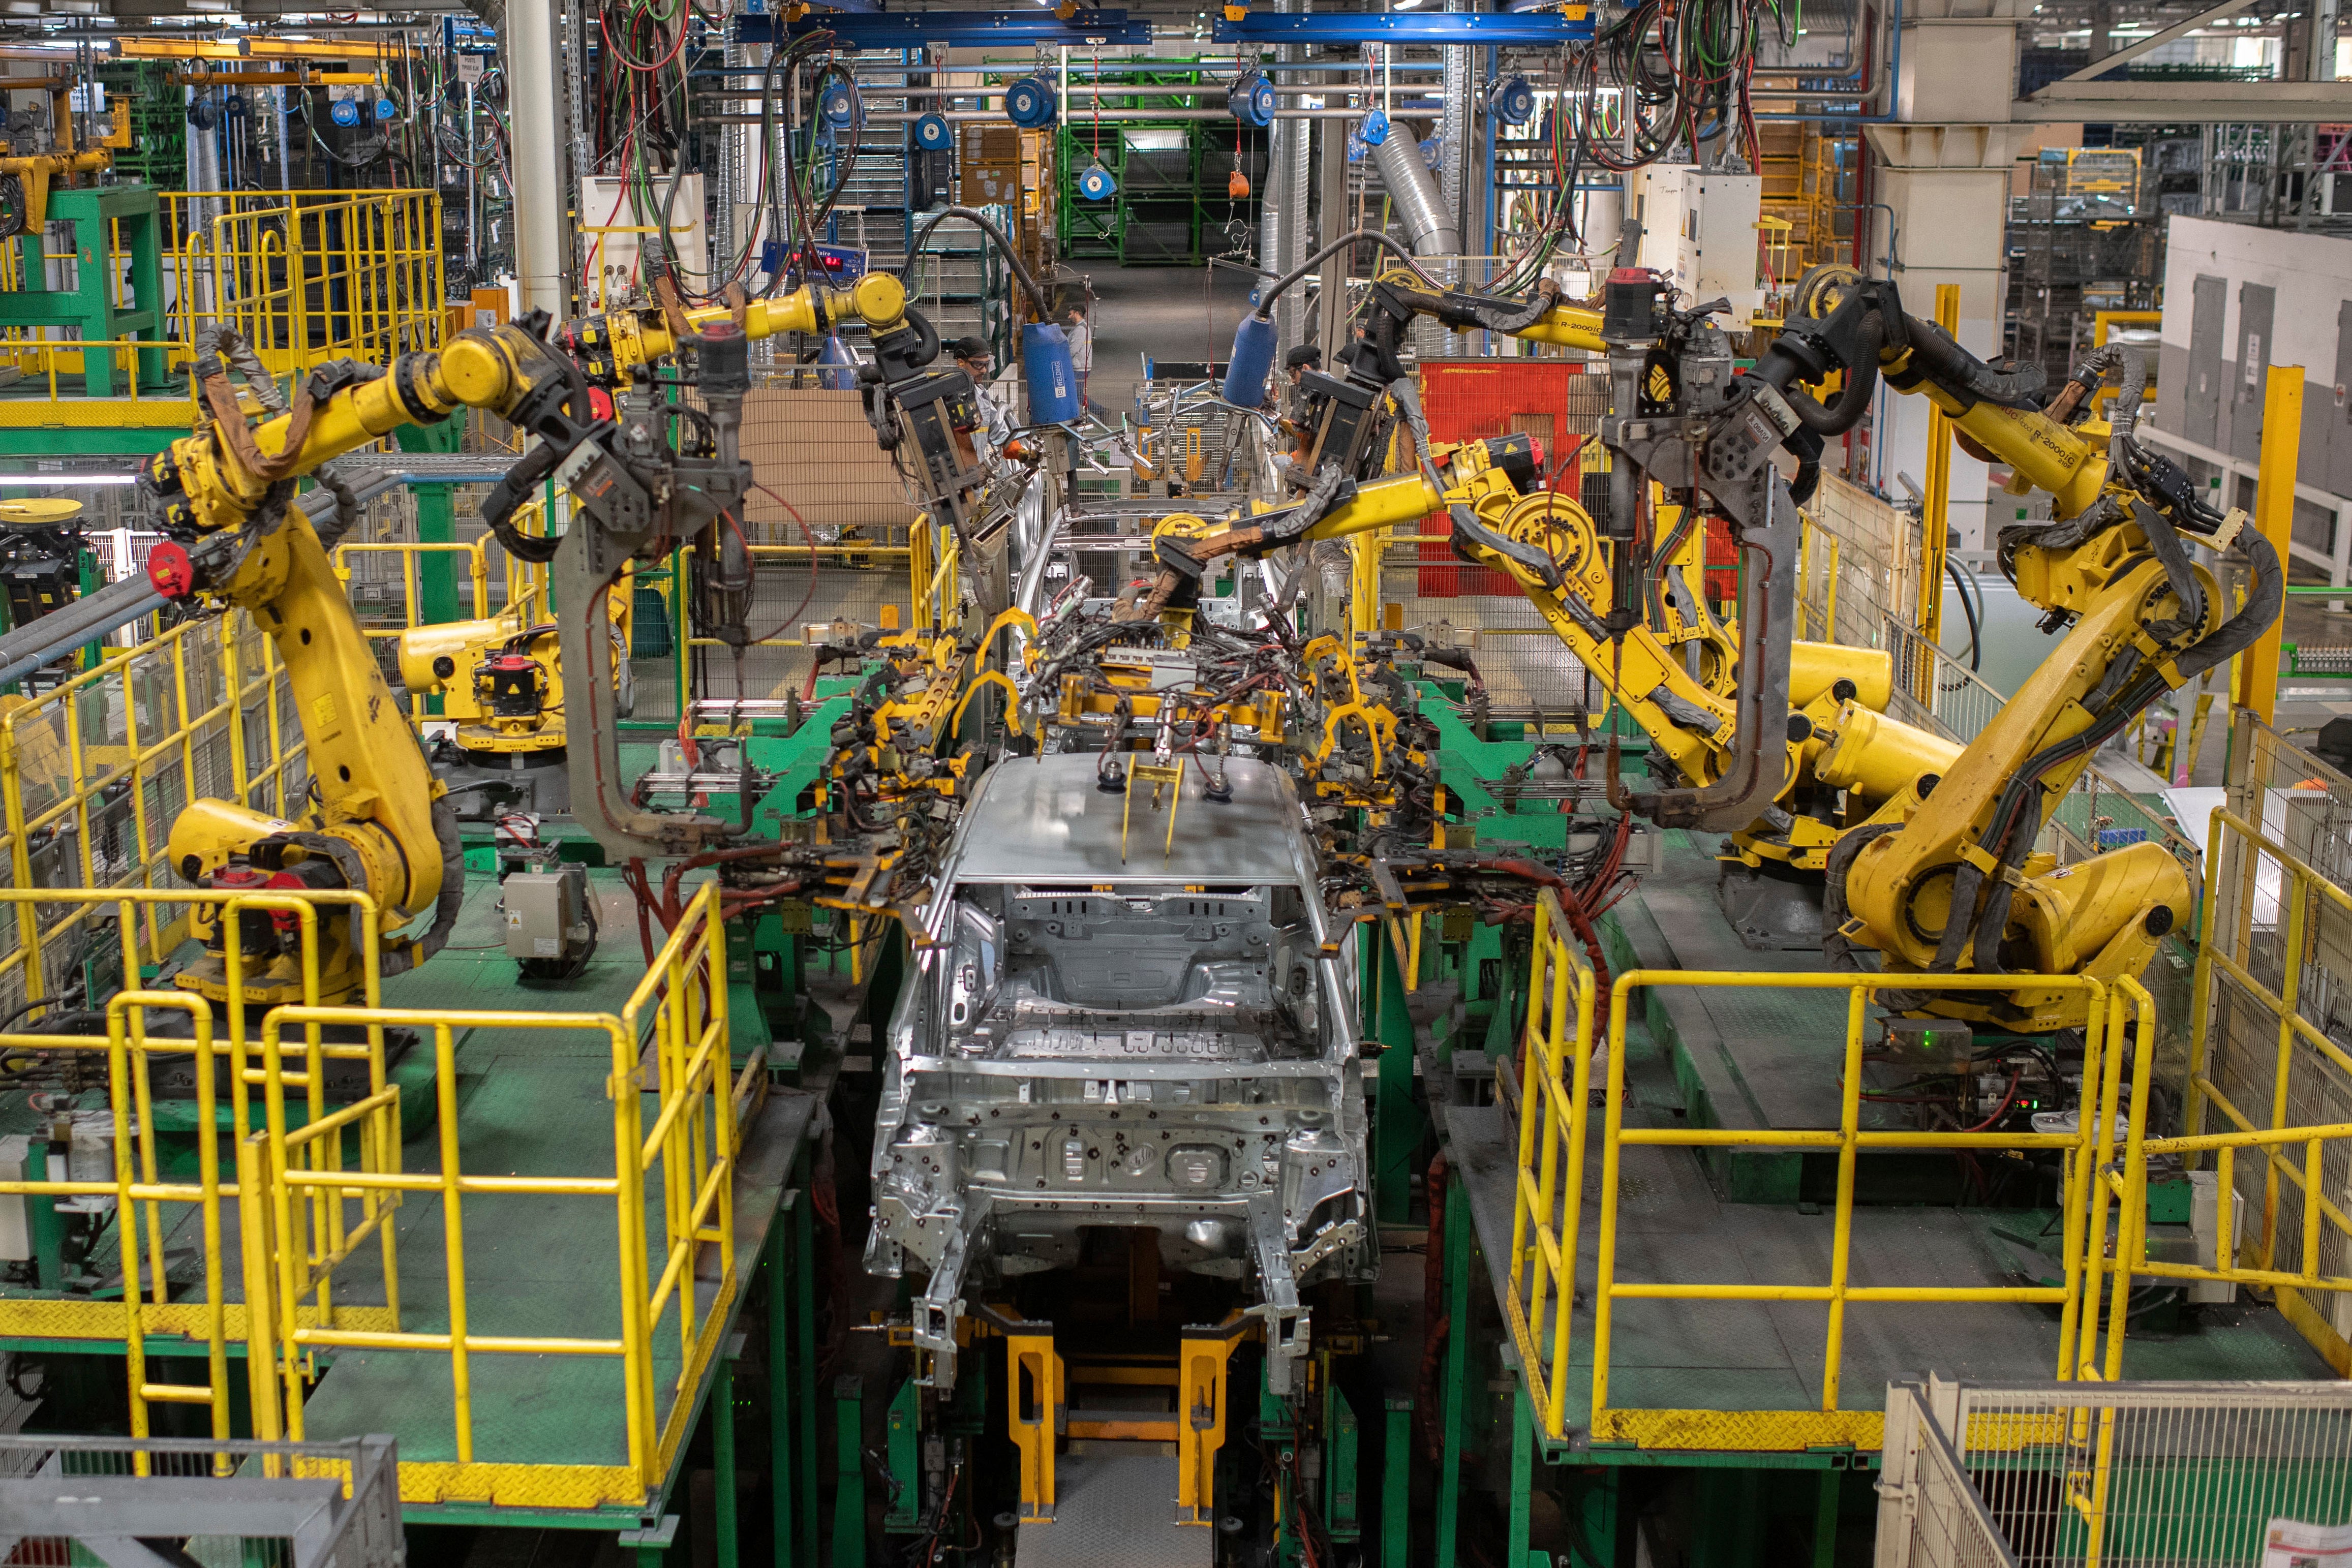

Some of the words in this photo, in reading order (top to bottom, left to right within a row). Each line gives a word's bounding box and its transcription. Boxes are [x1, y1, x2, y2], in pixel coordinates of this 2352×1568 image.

[1054, 361, 1062, 387] WELDING
[1753, 422, 1769, 441] OBARA
[1996, 405, 2018, 420] NUC
[2018, 417, 2033, 433] Robot
[2033, 429, 2075, 465] R-2000iC
[2058, 458, 2071, 469] 210F
